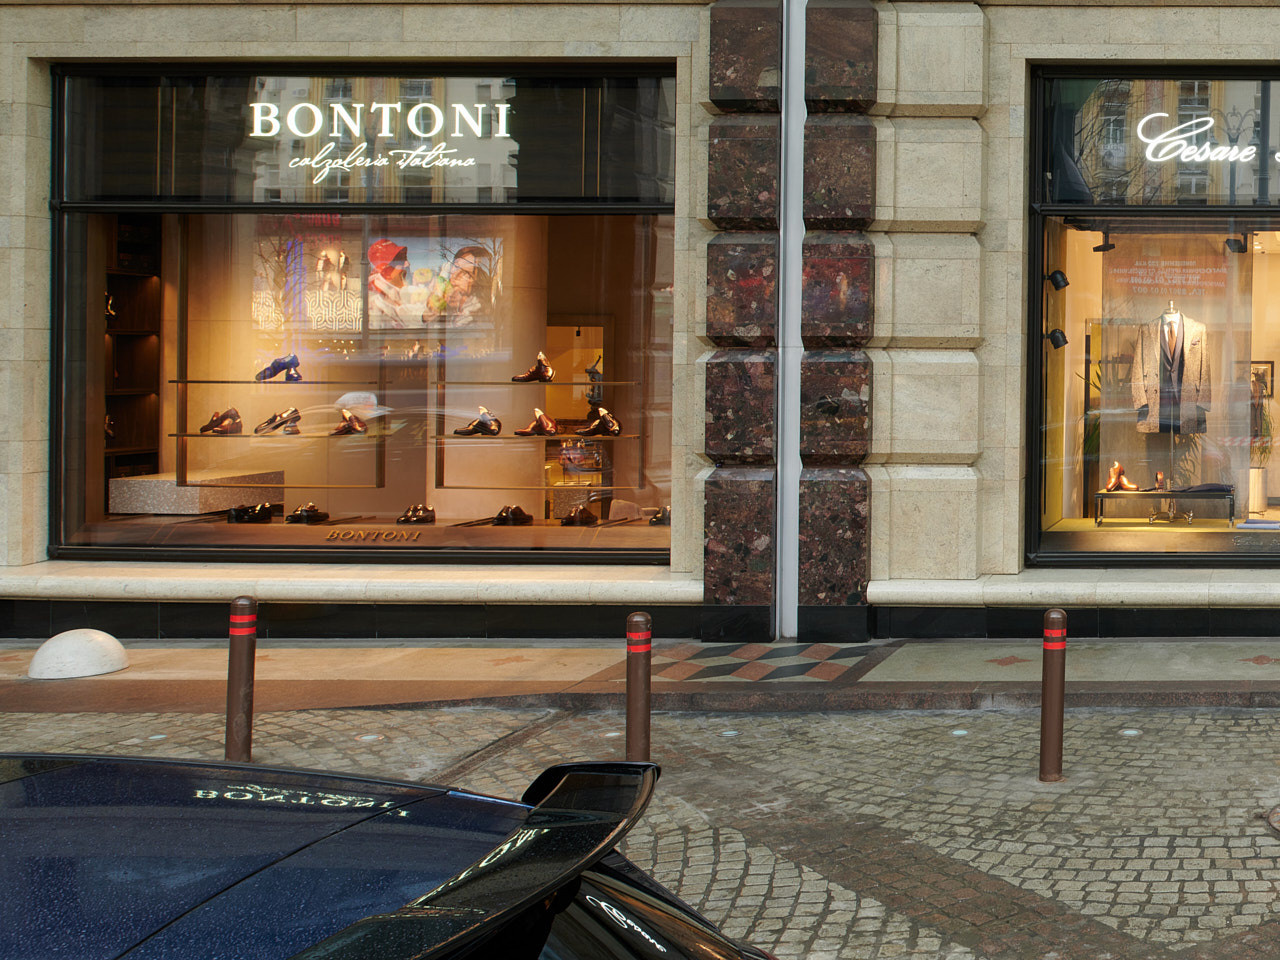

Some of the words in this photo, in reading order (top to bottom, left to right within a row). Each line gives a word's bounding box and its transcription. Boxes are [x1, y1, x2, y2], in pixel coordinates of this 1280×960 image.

[249, 102, 511, 138] BONTONI
[1137, 112, 1256, 162] Cesare
[288, 141, 389, 184] calzoleria
[389, 141, 476, 170] italiana
[325, 529, 422, 542] BONTONI
